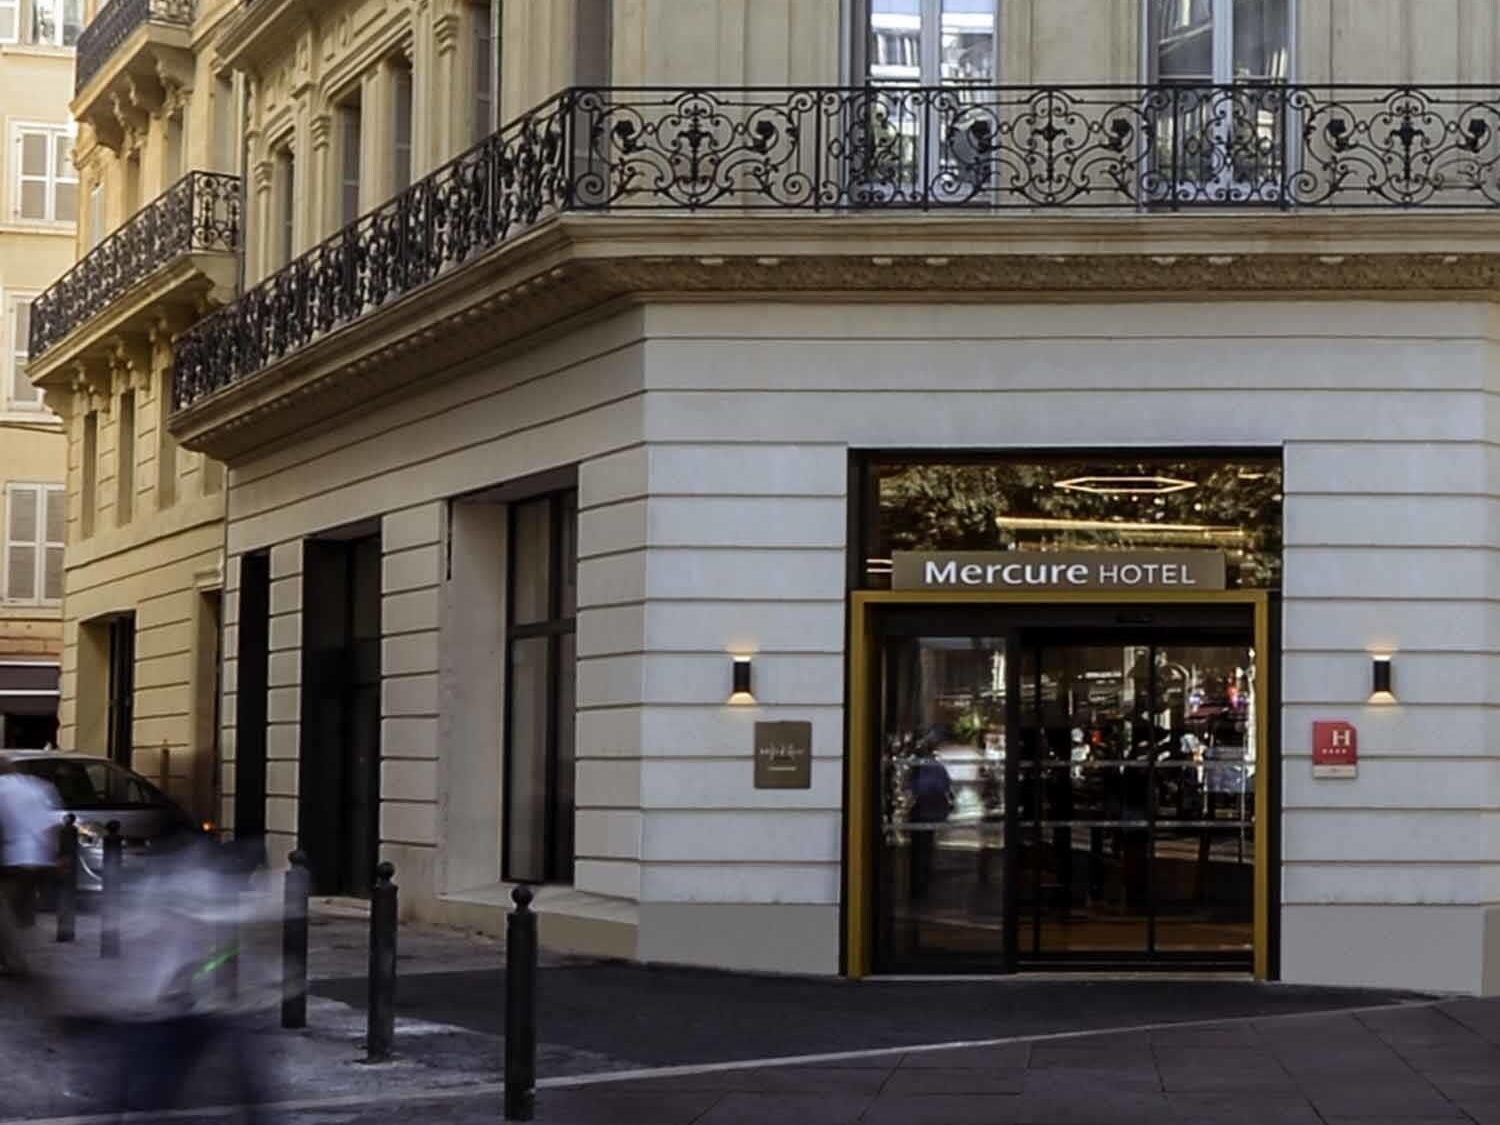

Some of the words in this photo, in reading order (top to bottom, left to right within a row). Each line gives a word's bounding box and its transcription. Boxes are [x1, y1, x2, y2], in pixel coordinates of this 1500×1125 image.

[925, 560, 1089, 585] Mercure
[1100, 563, 1196, 584] HOTEL
[1332, 729, 1351, 747] H
